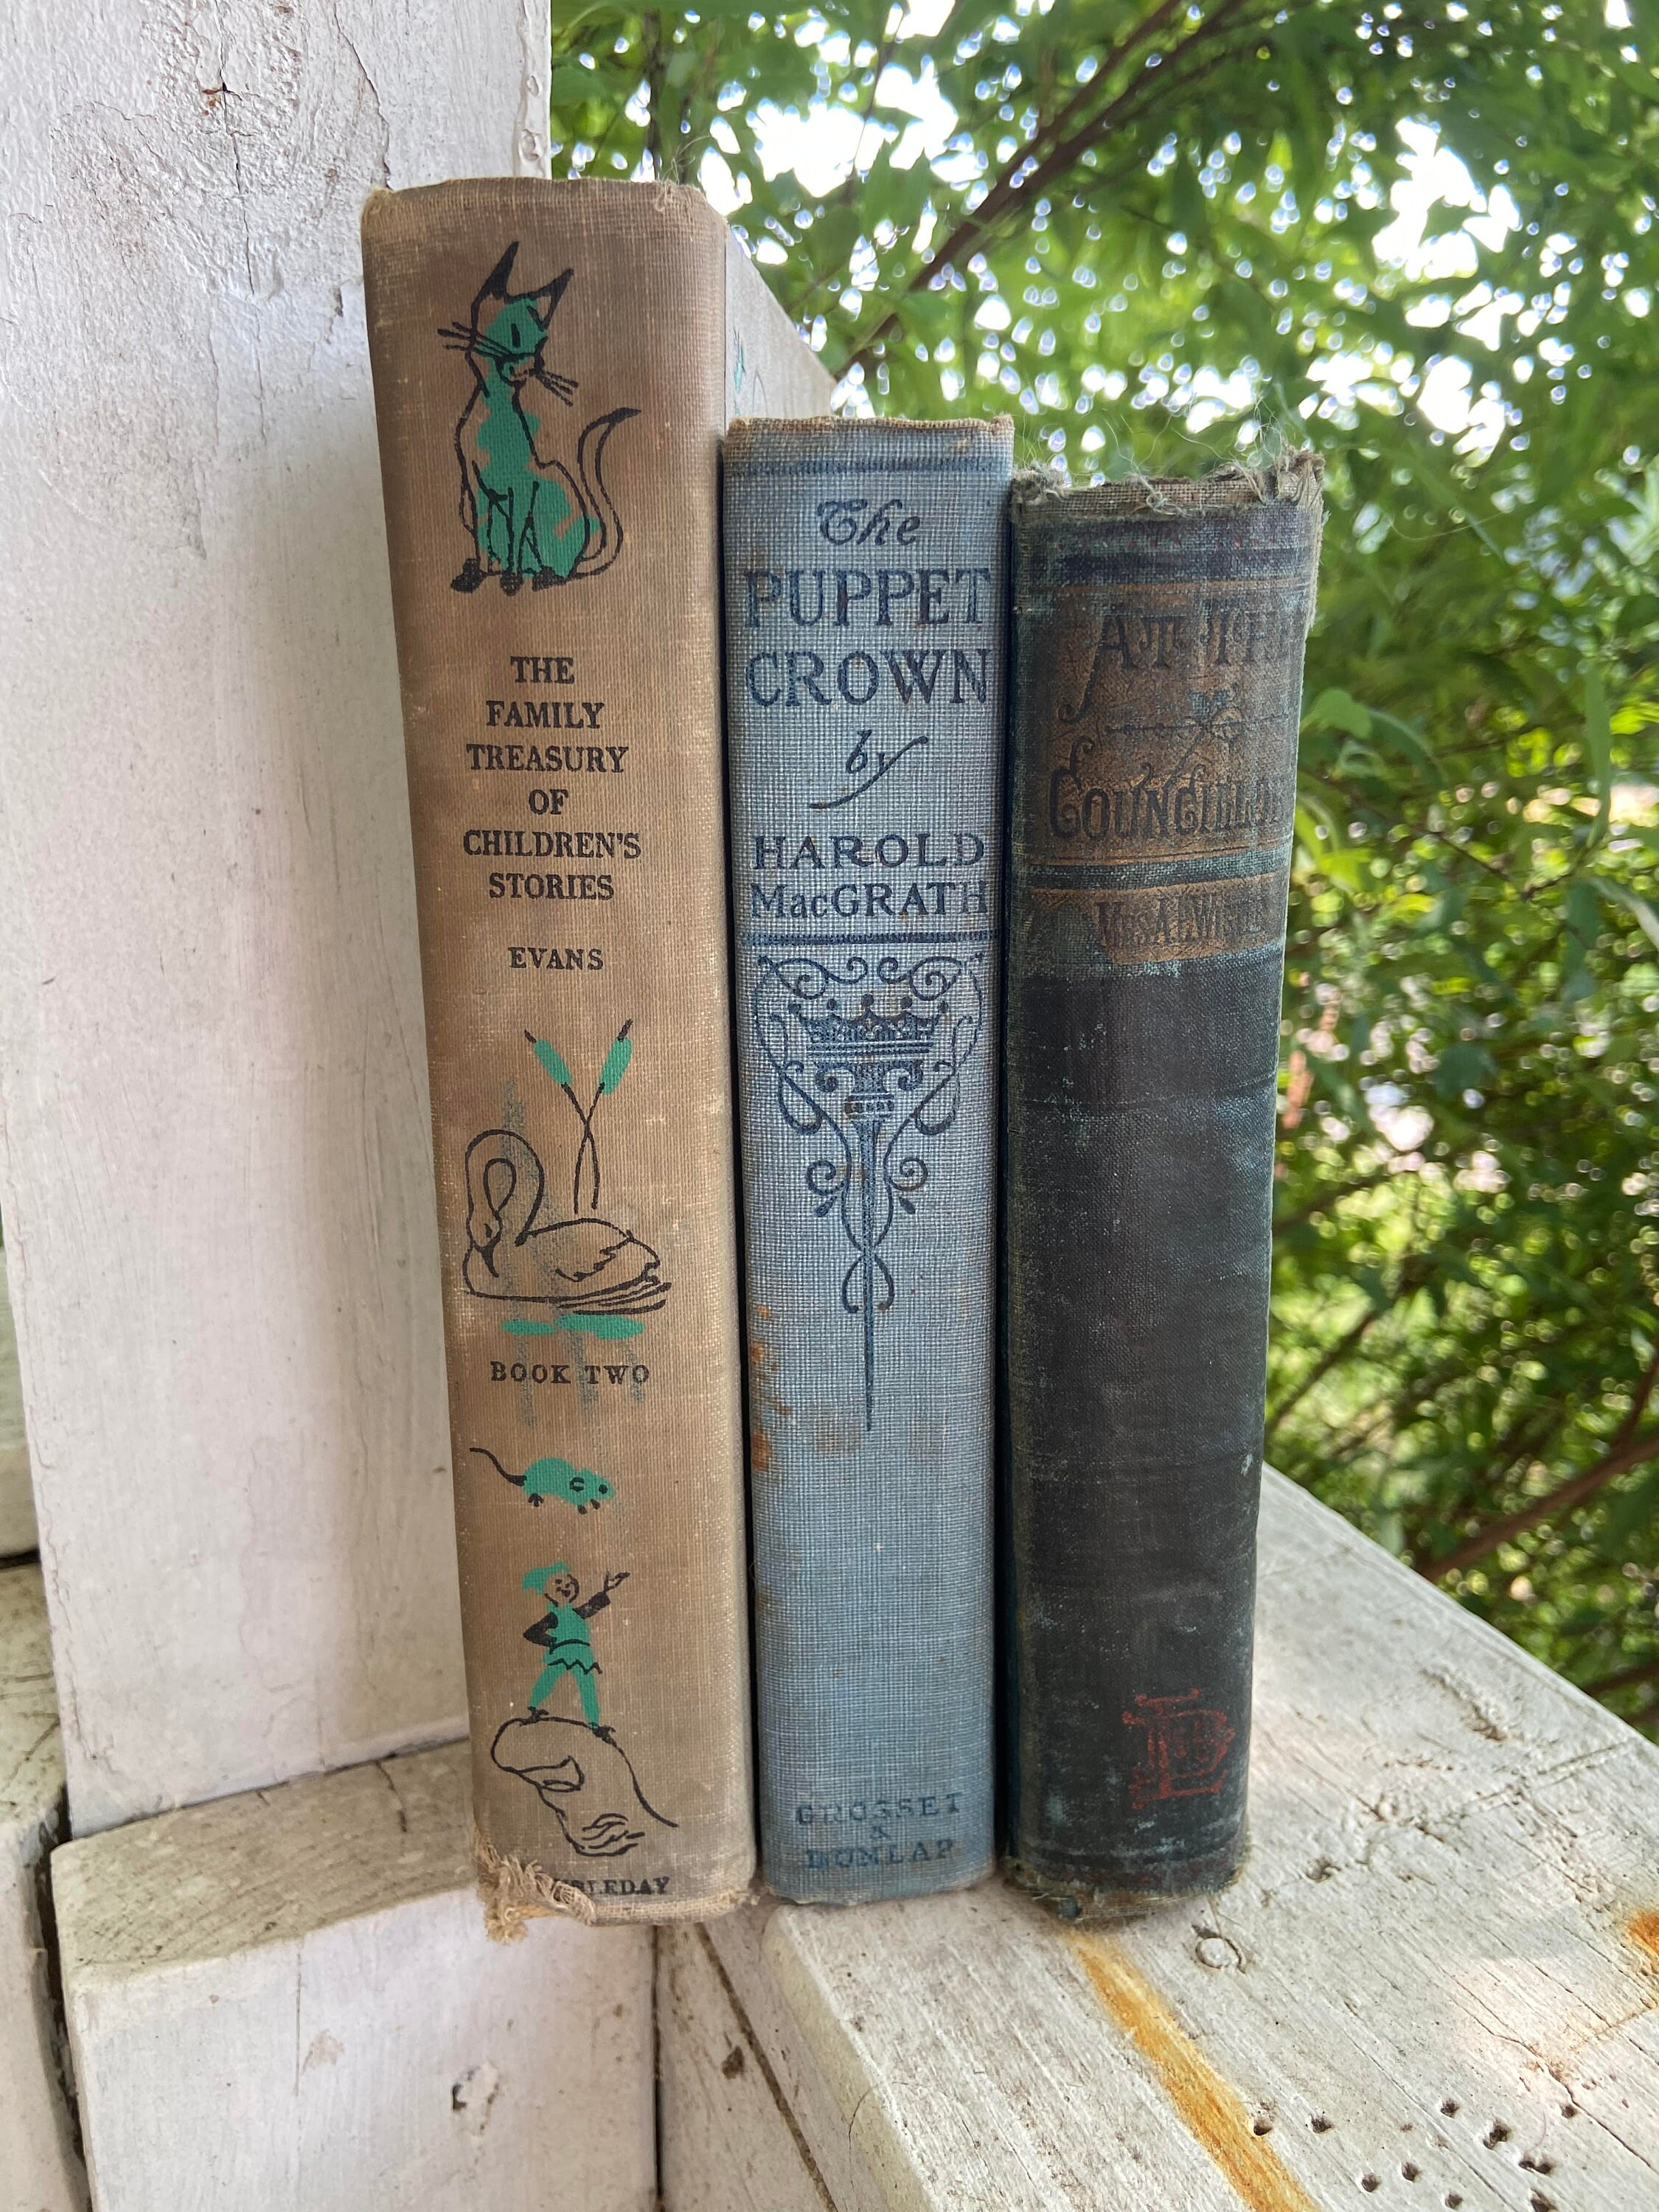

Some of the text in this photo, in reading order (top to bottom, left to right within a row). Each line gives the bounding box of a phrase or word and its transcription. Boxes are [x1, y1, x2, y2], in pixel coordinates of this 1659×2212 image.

[817, 499, 921, 546] The
[744, 568, 991, 627] PUPPET
[510, 656, 575, 684] THE
[745, 649, 991, 707] CROWN
[486, 700, 605, 729] FAMILY
[466, 743, 629, 773] TREASURY
[809, 729, 928, 810] by
[528, 788, 568, 815] OF
[463, 830, 641, 859] CHILDREN'S
[750, 832, 985, 870] HAROLD
[489, 872, 614, 900] STORIES
[750, 880, 990, 919] MacGRATH
[508, 947, 604, 970] EVANS
[490, 1361, 650, 1386] BOOK TWO
[806, 1839, 954, 1870] DUNLAP
